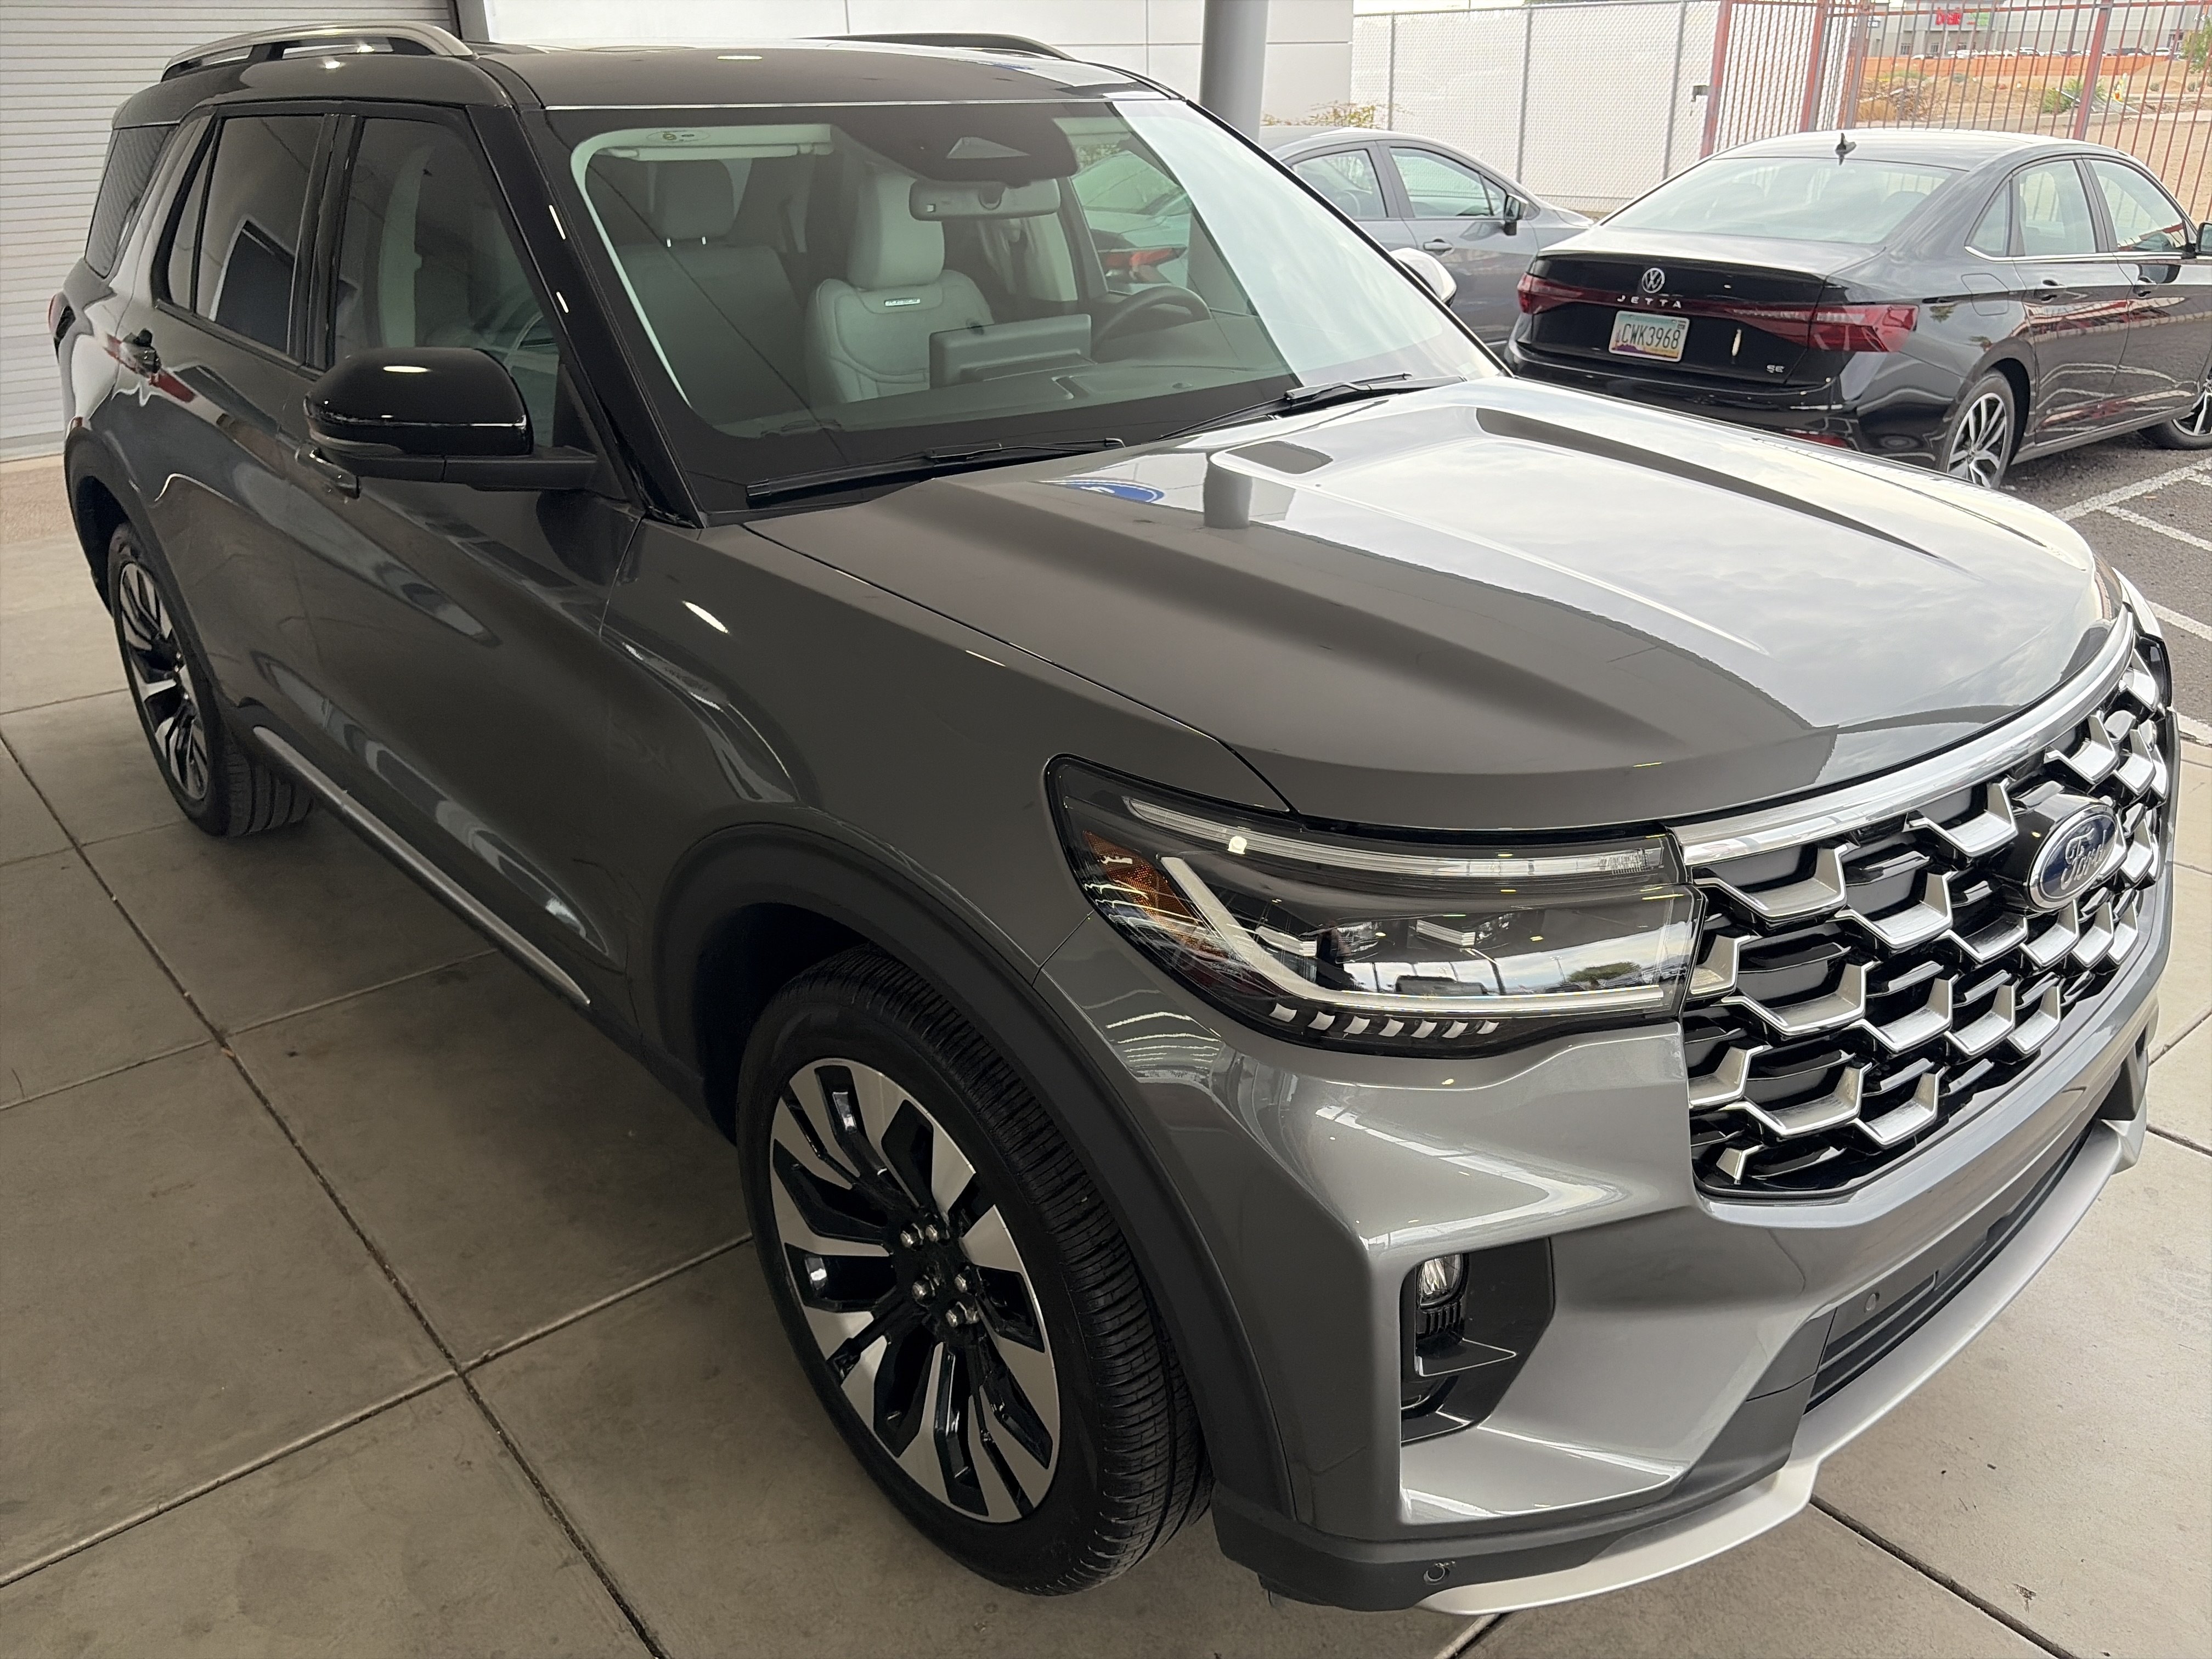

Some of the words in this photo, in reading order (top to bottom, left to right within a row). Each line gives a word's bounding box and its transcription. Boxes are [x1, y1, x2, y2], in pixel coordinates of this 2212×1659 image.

[1617, 295, 1681, 308] JETTA
[1622, 324, 1681, 349] CWK3968
[1767, 365, 1784, 373] SE
[2061, 827, 2107, 890] Ford
